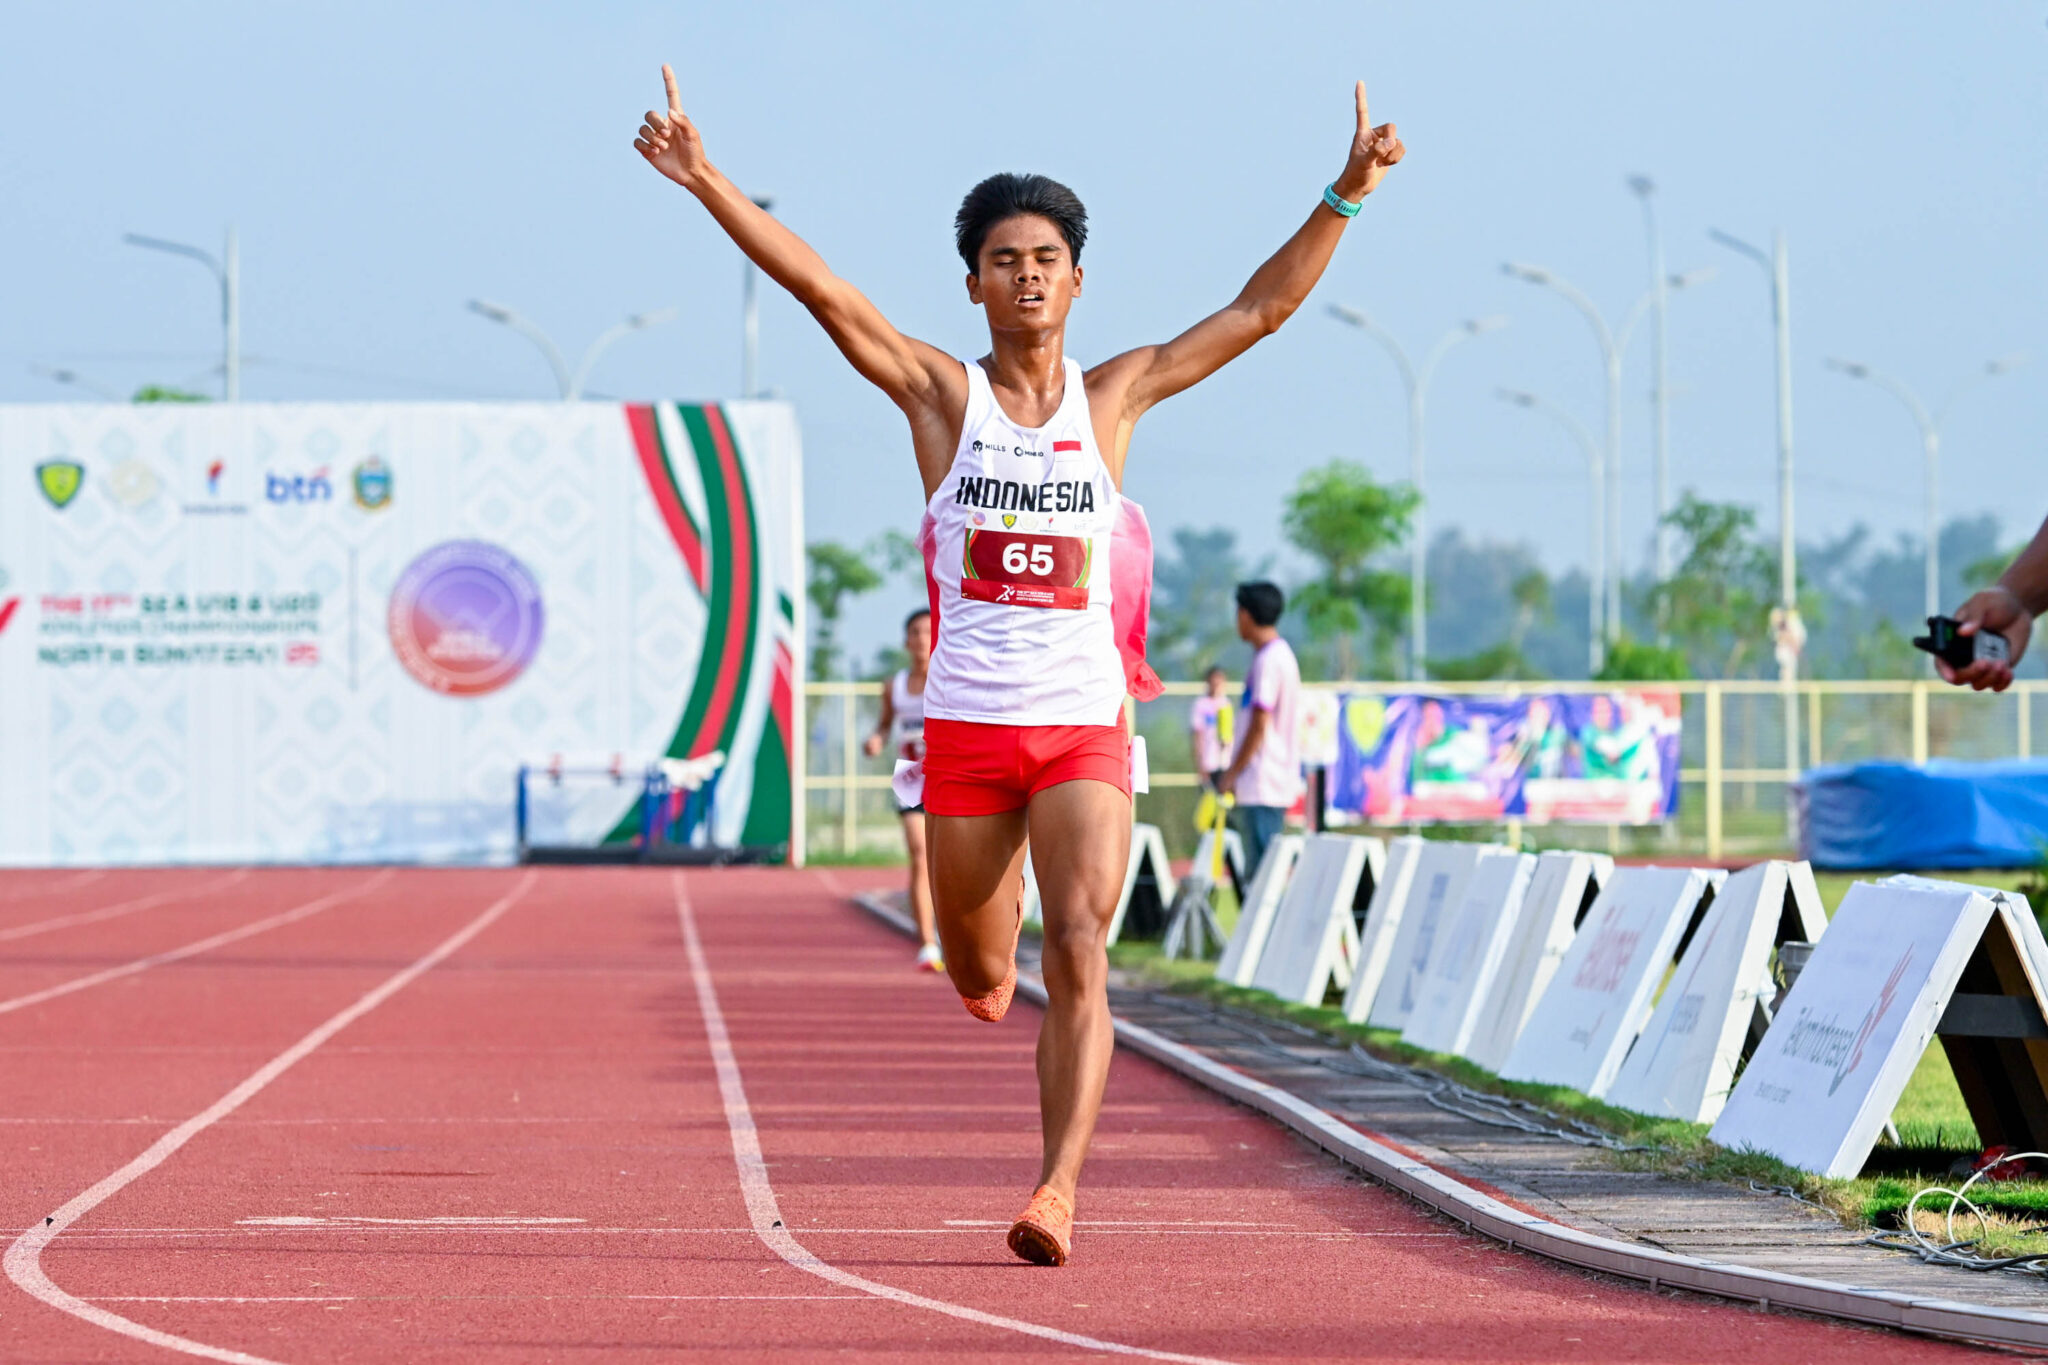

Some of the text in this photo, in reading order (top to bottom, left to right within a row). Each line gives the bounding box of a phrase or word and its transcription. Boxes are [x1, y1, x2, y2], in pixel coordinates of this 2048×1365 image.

[985, 443, 1006, 453] MILLS
[265, 467, 332, 504] btn
[955, 476, 1095, 513] INDONESIA
[1002, 542, 1054, 576] 65
